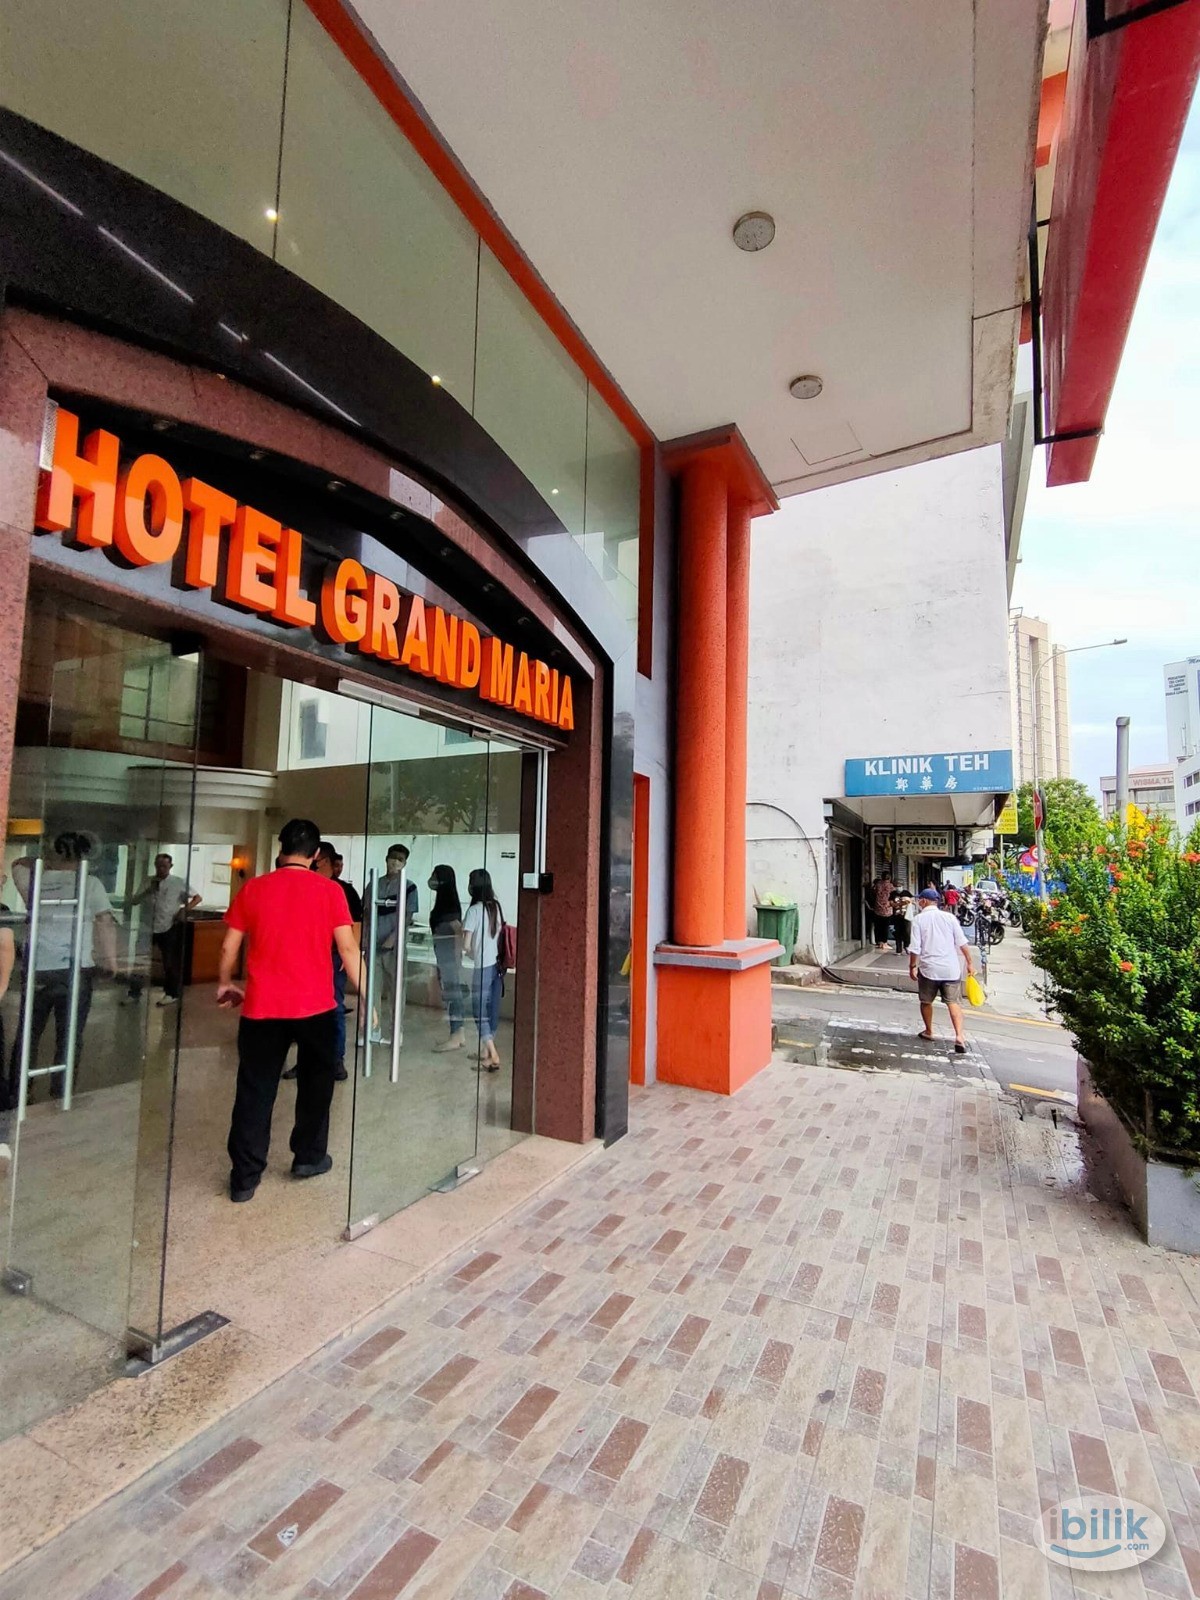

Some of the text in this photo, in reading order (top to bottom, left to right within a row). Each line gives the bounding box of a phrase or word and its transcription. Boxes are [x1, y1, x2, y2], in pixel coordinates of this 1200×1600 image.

[36, 402, 575, 731] HOTEL GRAND MARIA
[864, 753, 989, 776] KLINIK TEH
[905, 837, 947, 846] CASINO
